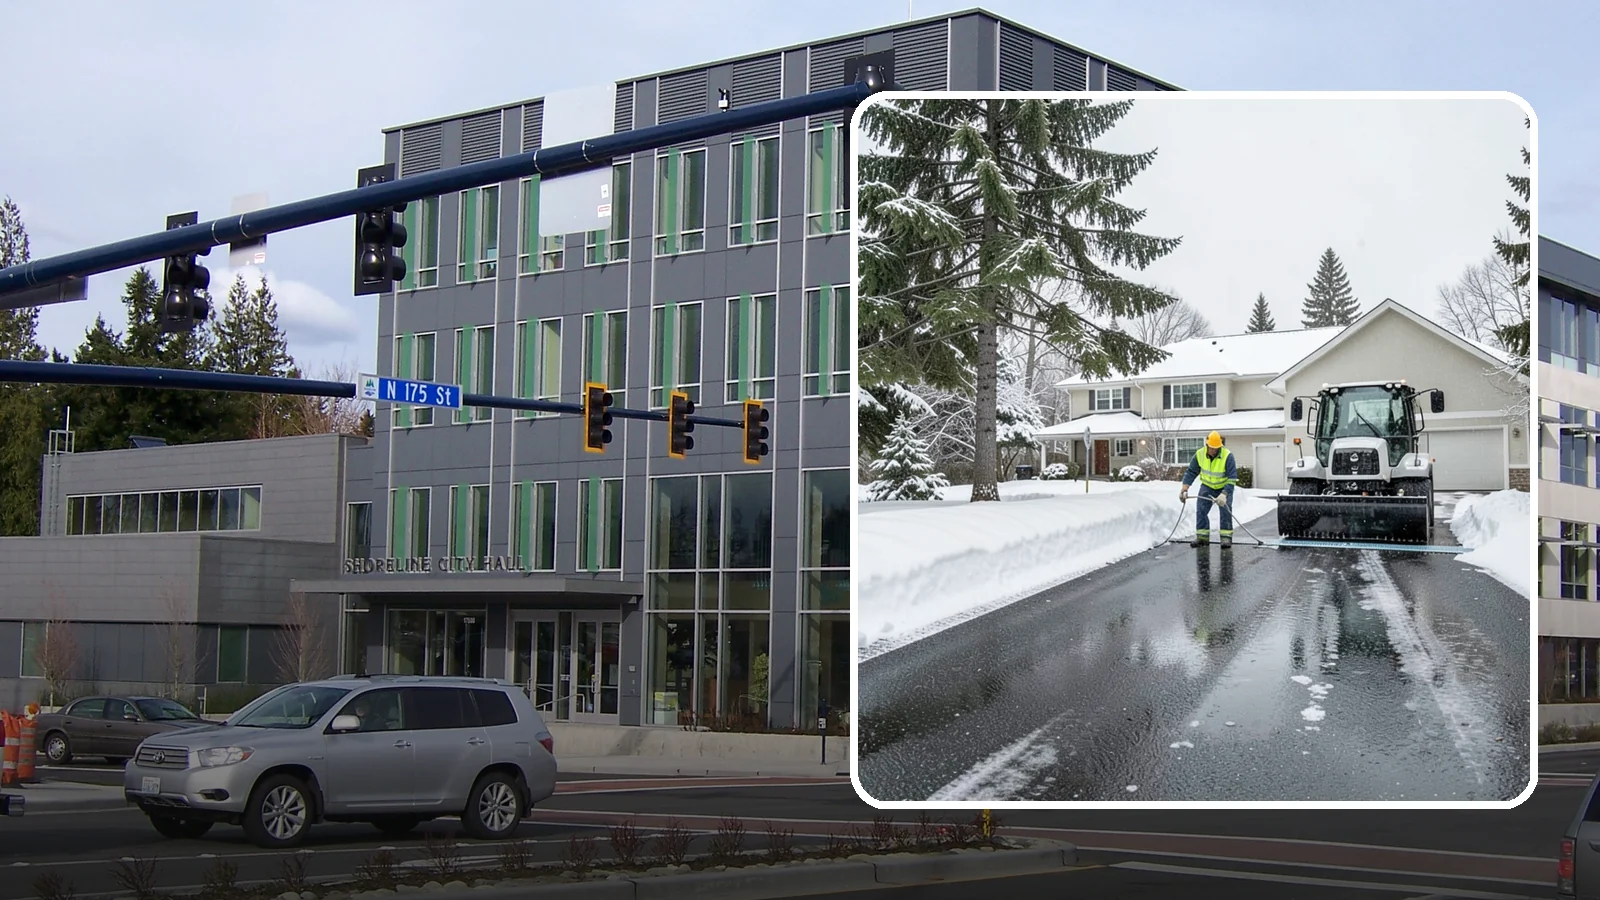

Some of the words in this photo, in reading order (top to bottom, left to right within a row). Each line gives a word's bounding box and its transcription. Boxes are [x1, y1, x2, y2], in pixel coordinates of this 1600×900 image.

[387, 380, 396, 399] N
[405, 382, 427, 402] 175
[436, 386, 451, 406] St
[343, 556, 432, 574] SHORELINE
[438, 556, 475, 572] CITY
[483, 555, 525, 571] HALL
